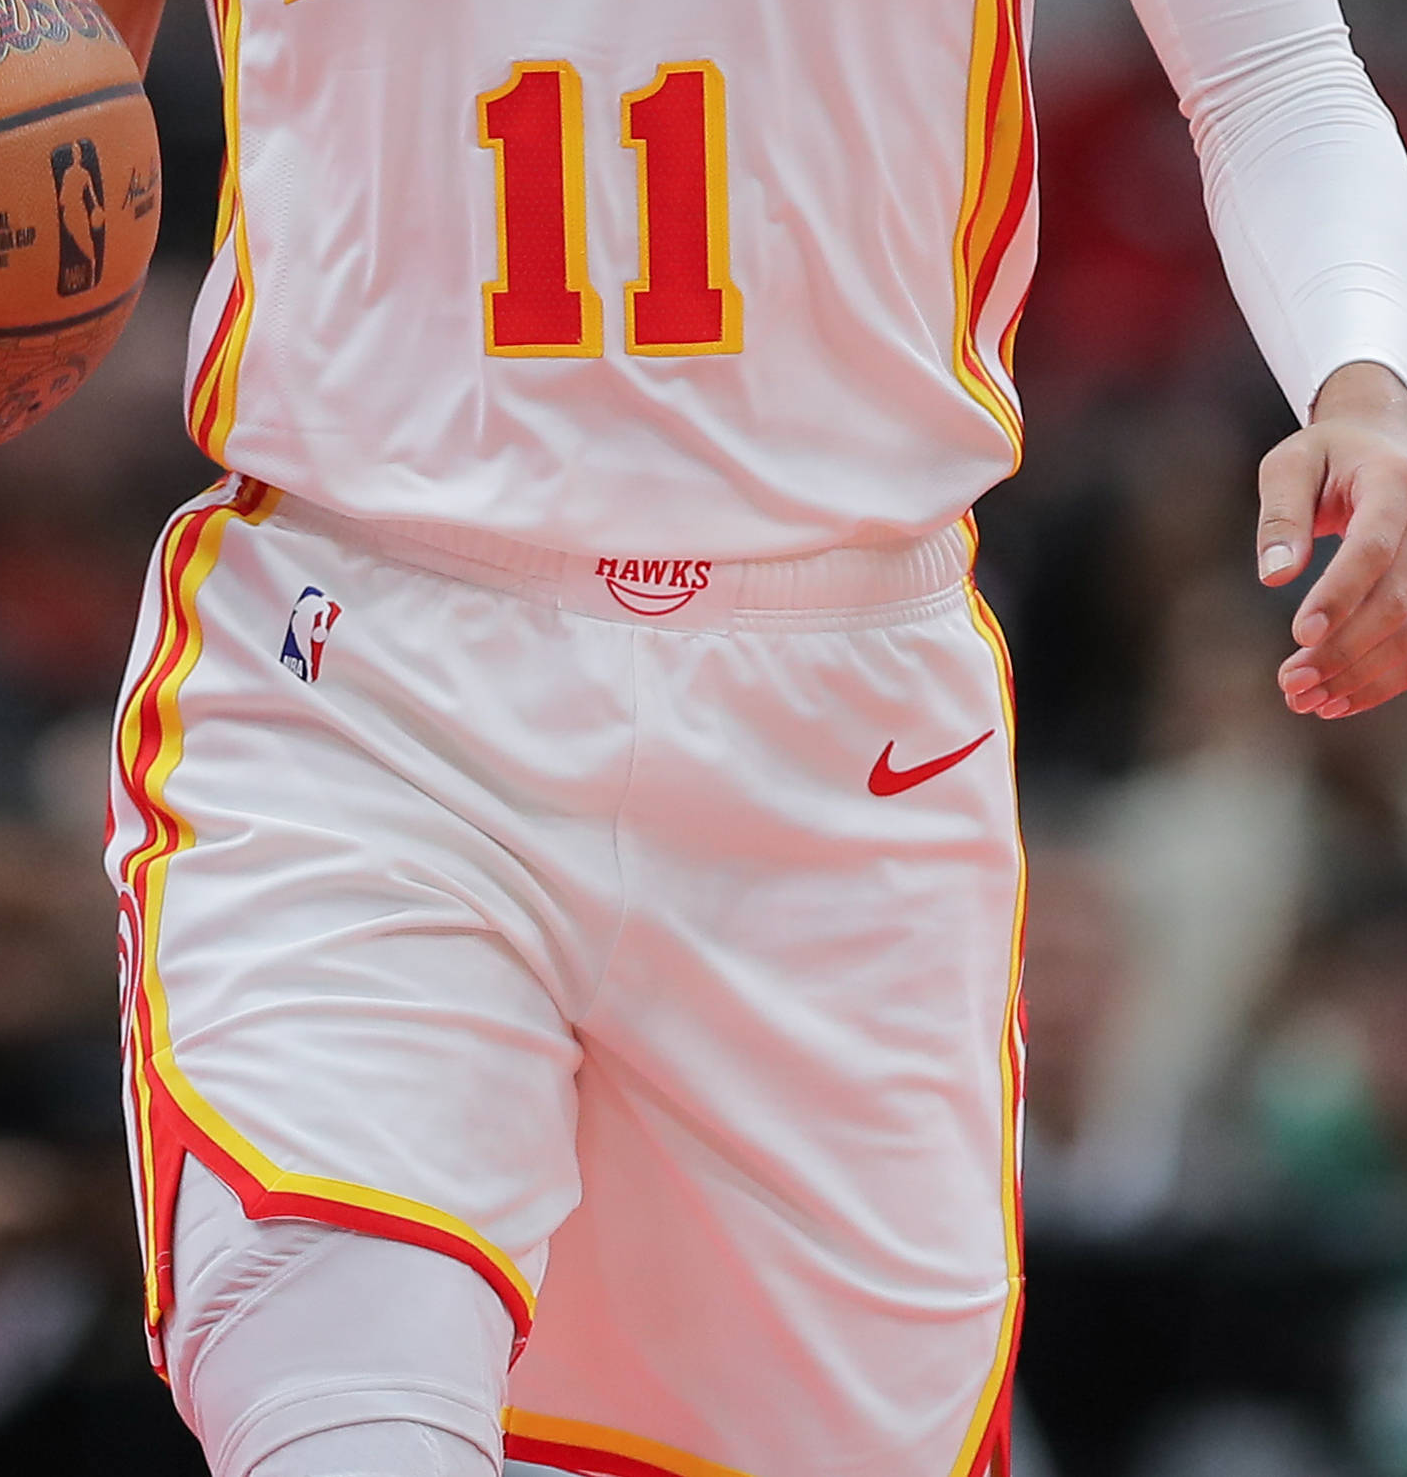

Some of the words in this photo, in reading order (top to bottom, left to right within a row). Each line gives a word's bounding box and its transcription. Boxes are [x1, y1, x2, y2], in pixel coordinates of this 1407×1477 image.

[476, 60, 743, 359] 11
[16, 226, 36, 249] CUP
[595, 556, 712, 590] HAWKS
